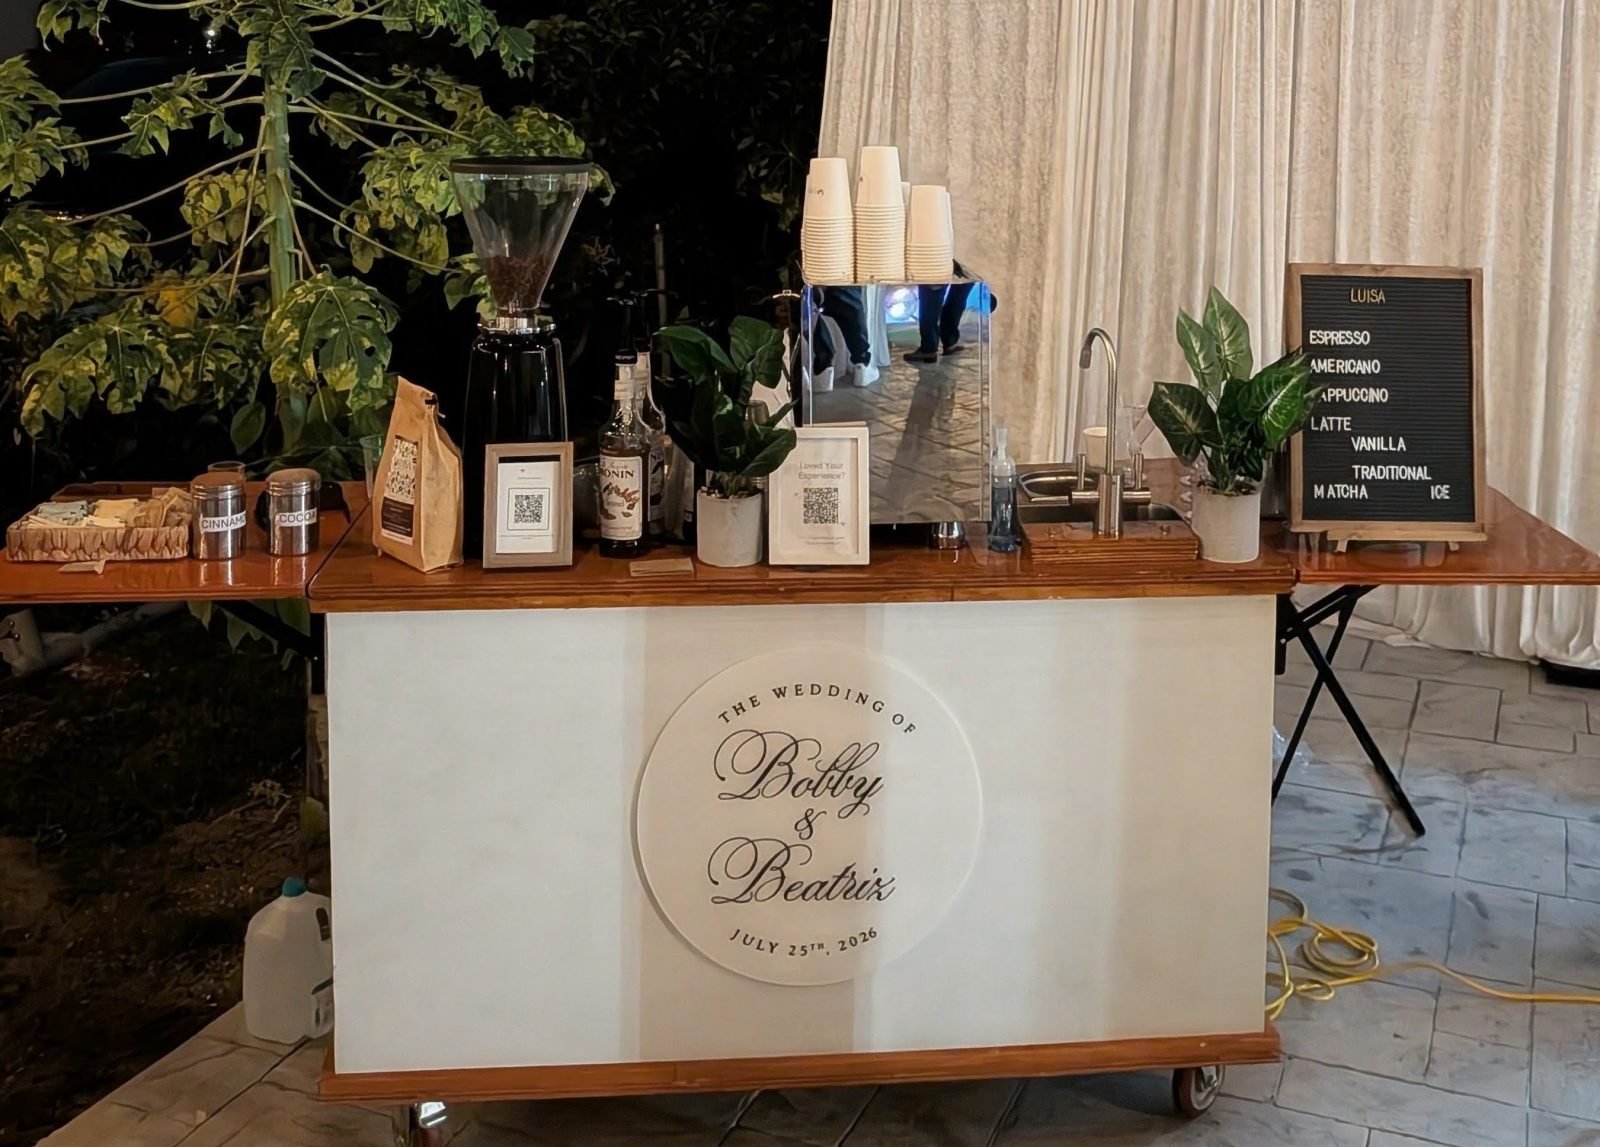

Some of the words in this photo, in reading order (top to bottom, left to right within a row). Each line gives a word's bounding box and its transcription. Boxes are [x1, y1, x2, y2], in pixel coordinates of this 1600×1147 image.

[1350, 287, 1386, 304] LUISA
[1309, 329, 1371, 346] ESPRESSO
[1310, 358, 1381, 374] AMERICANO
[1321, 387, 1389, 403] APPUCCINO
[1311, 416, 1352, 432] LATTE
[1351, 436, 1407, 452] VANILLA
[1352, 465, 1432, 480] TRADITIONAL
[1314, 484, 1369, 499] MATCHA
[1431, 485, 1451, 500] ICE
[718, 695, 761, 724] THE
[772, 683, 885, 713] WEDDING
[891, 713, 916, 734] OF
[713, 729, 884, 819] Bobby
[794, 808, 827, 840] &
[707, 837, 896, 905] Beatriz
[729, 928, 779, 954] JULY
[838, 926, 878, 951] 2026
